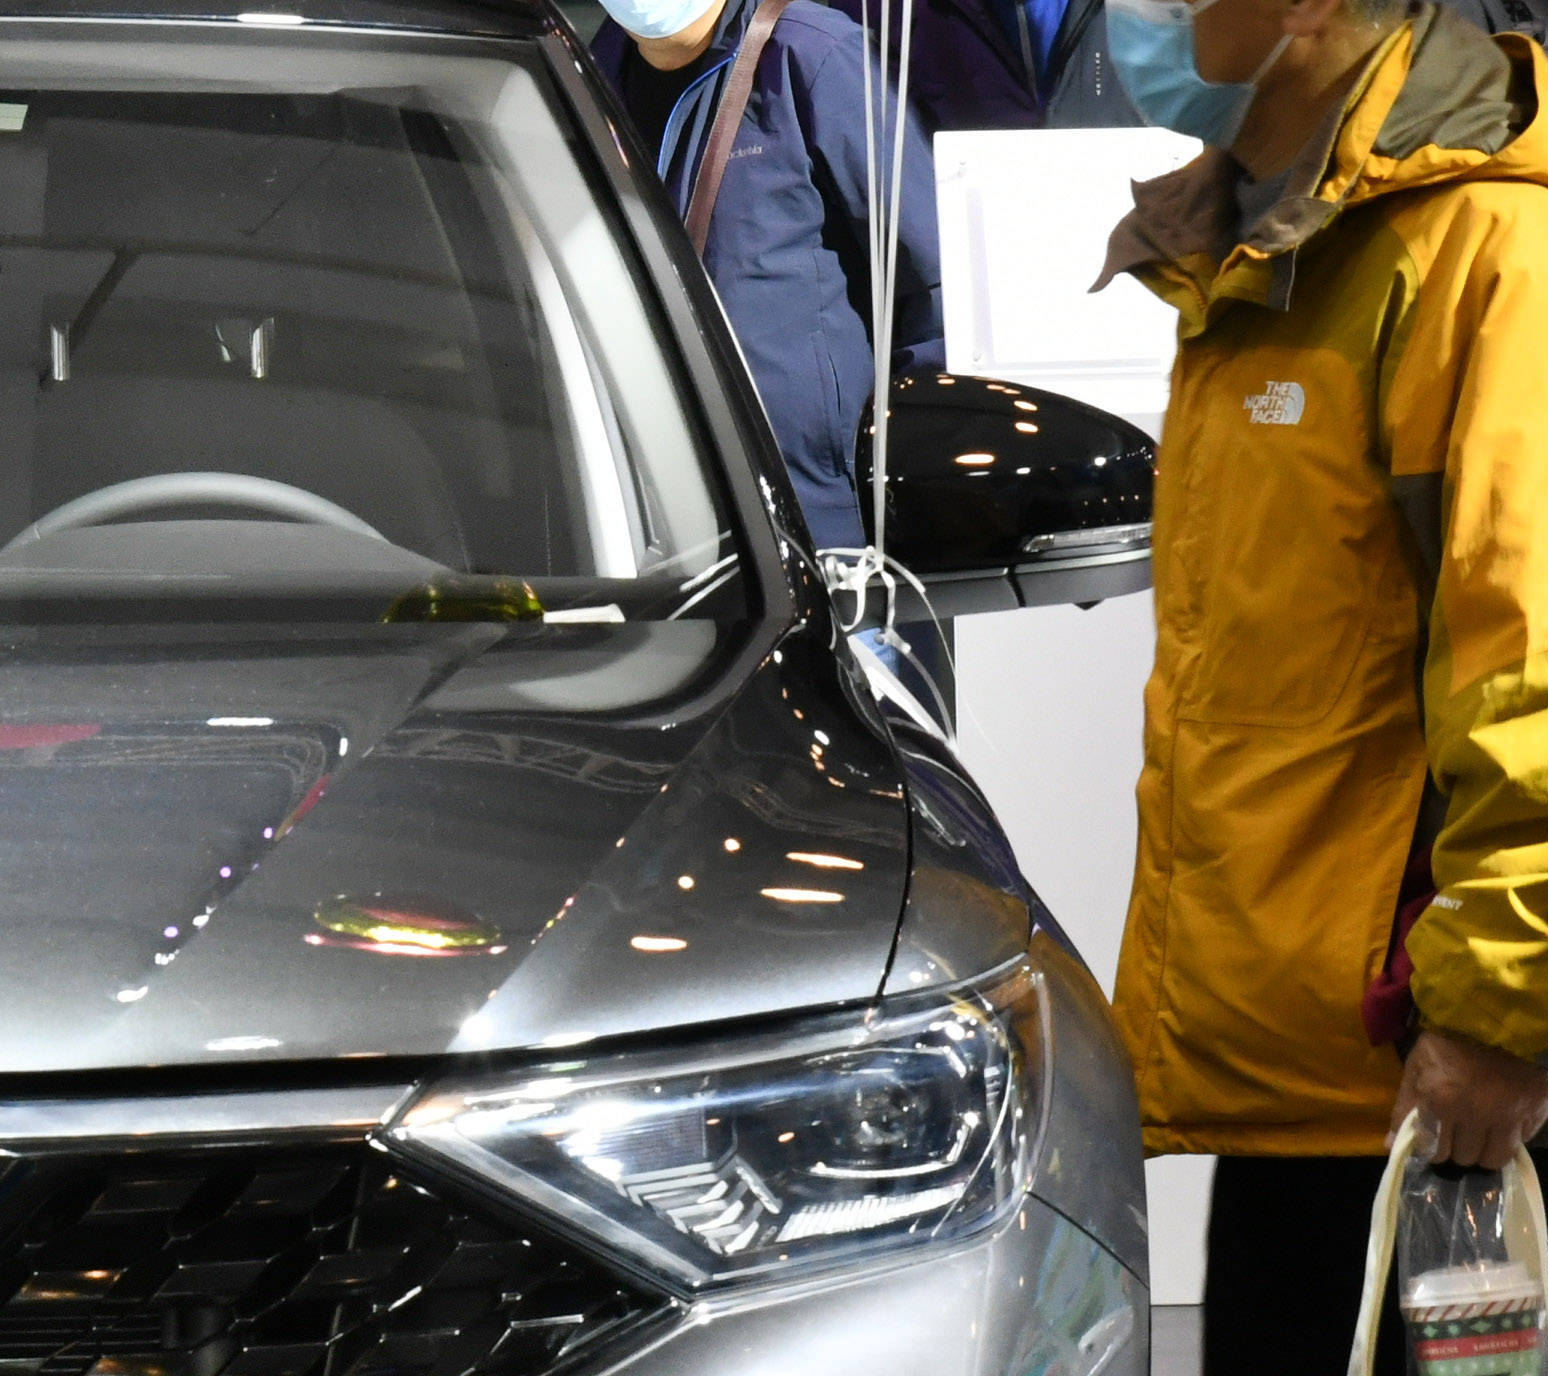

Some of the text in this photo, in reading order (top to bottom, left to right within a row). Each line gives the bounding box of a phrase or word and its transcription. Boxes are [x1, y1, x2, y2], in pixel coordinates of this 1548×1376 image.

[1265, 380, 1290, 396] THE
[1243, 394, 1286, 410] NORTH
[1250, 409, 1284, 424] FACE
